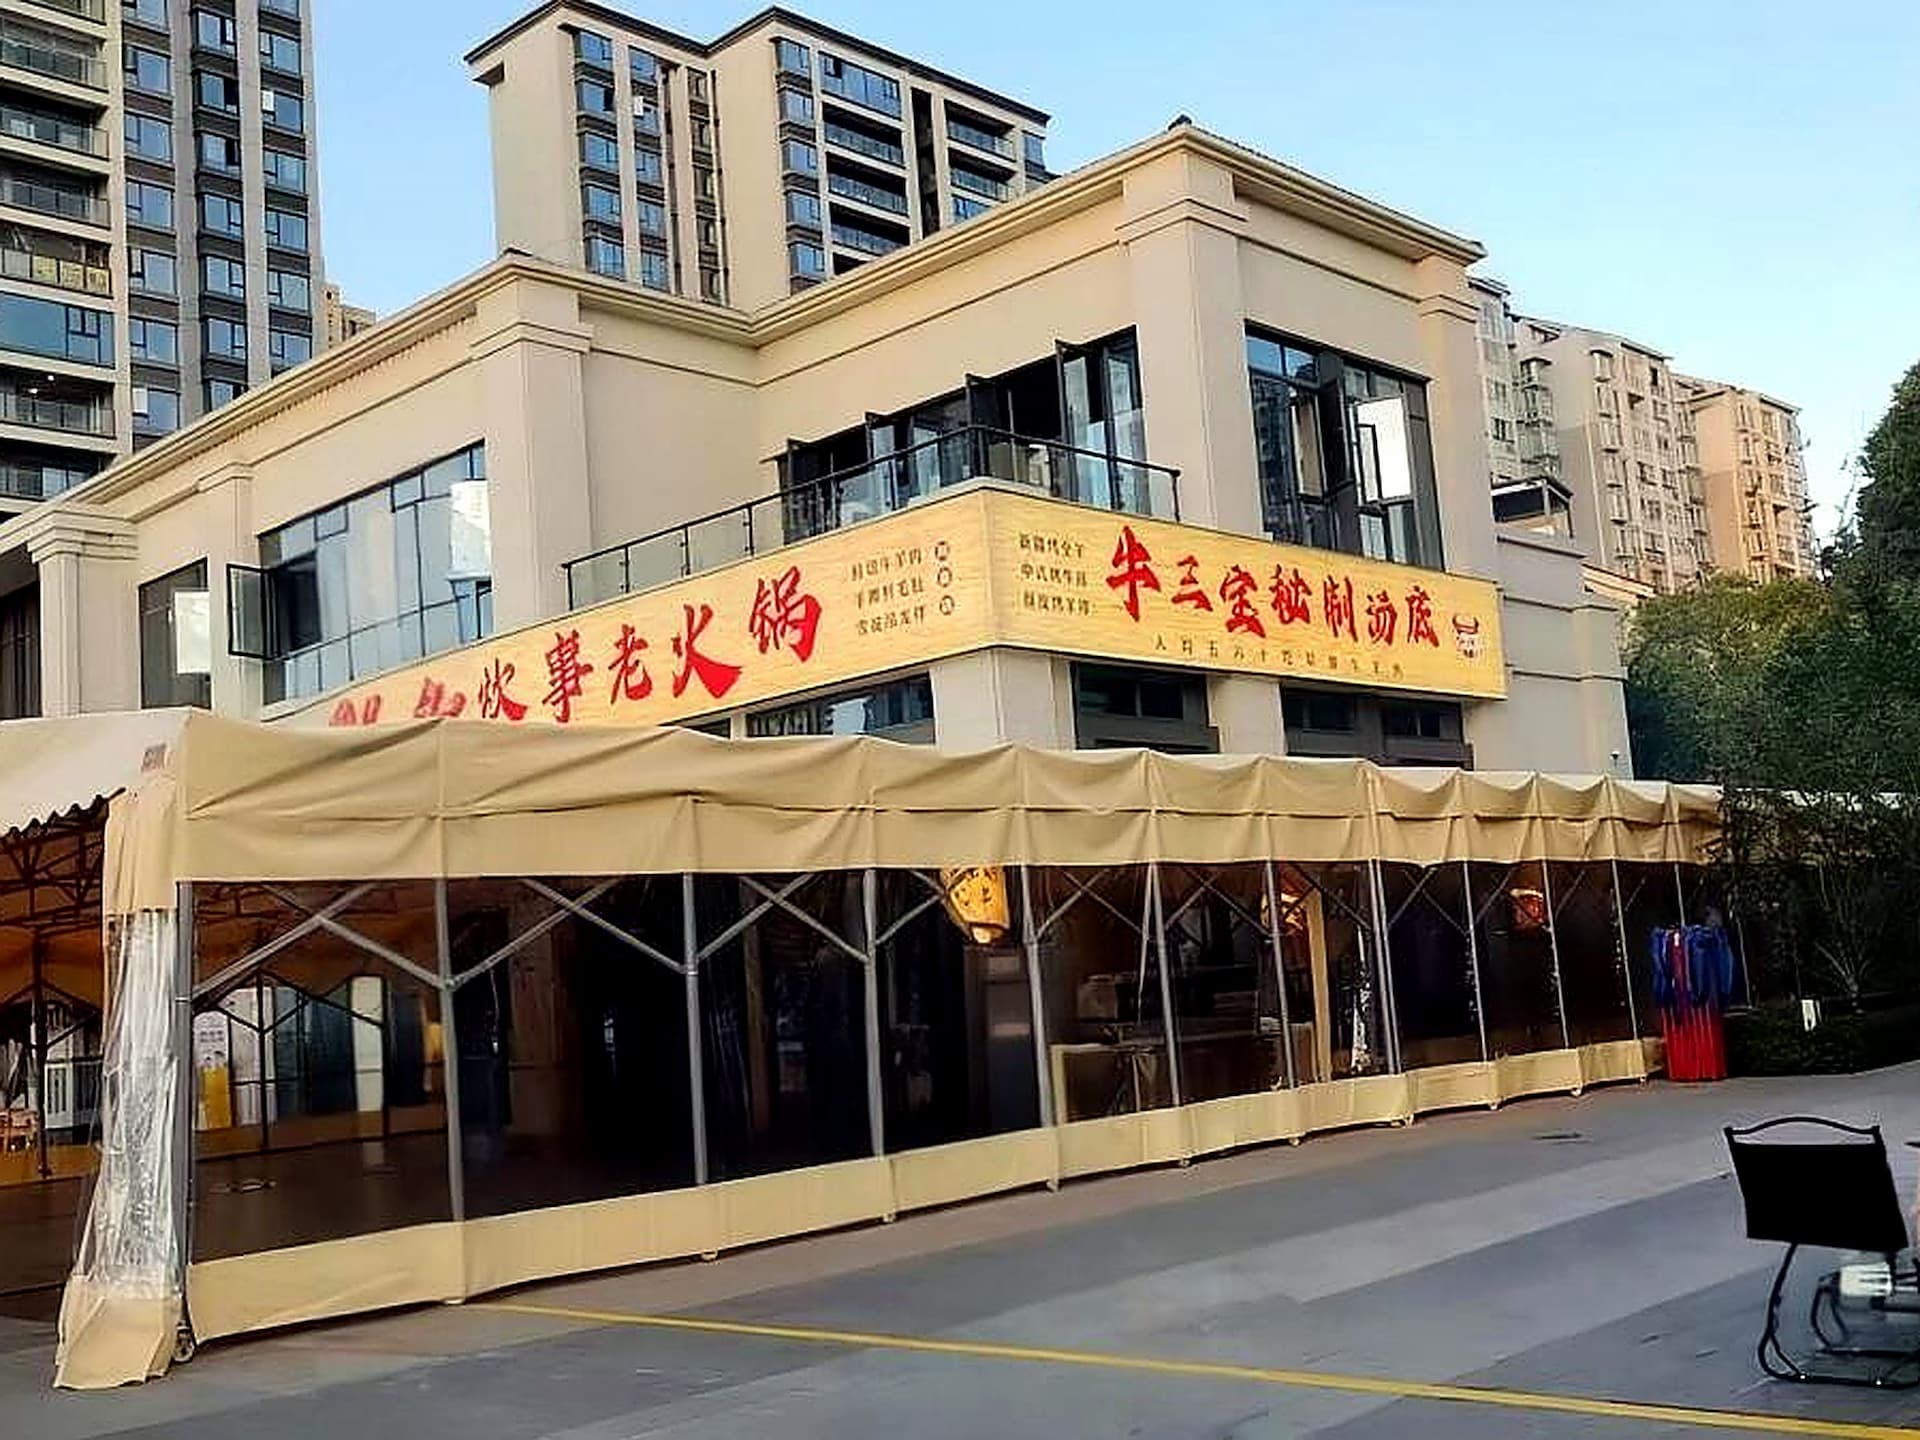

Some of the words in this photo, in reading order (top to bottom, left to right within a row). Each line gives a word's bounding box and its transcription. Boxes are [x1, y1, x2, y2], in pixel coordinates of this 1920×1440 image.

[1105, 526, 1440, 648] 牛三宝秘制汤底
